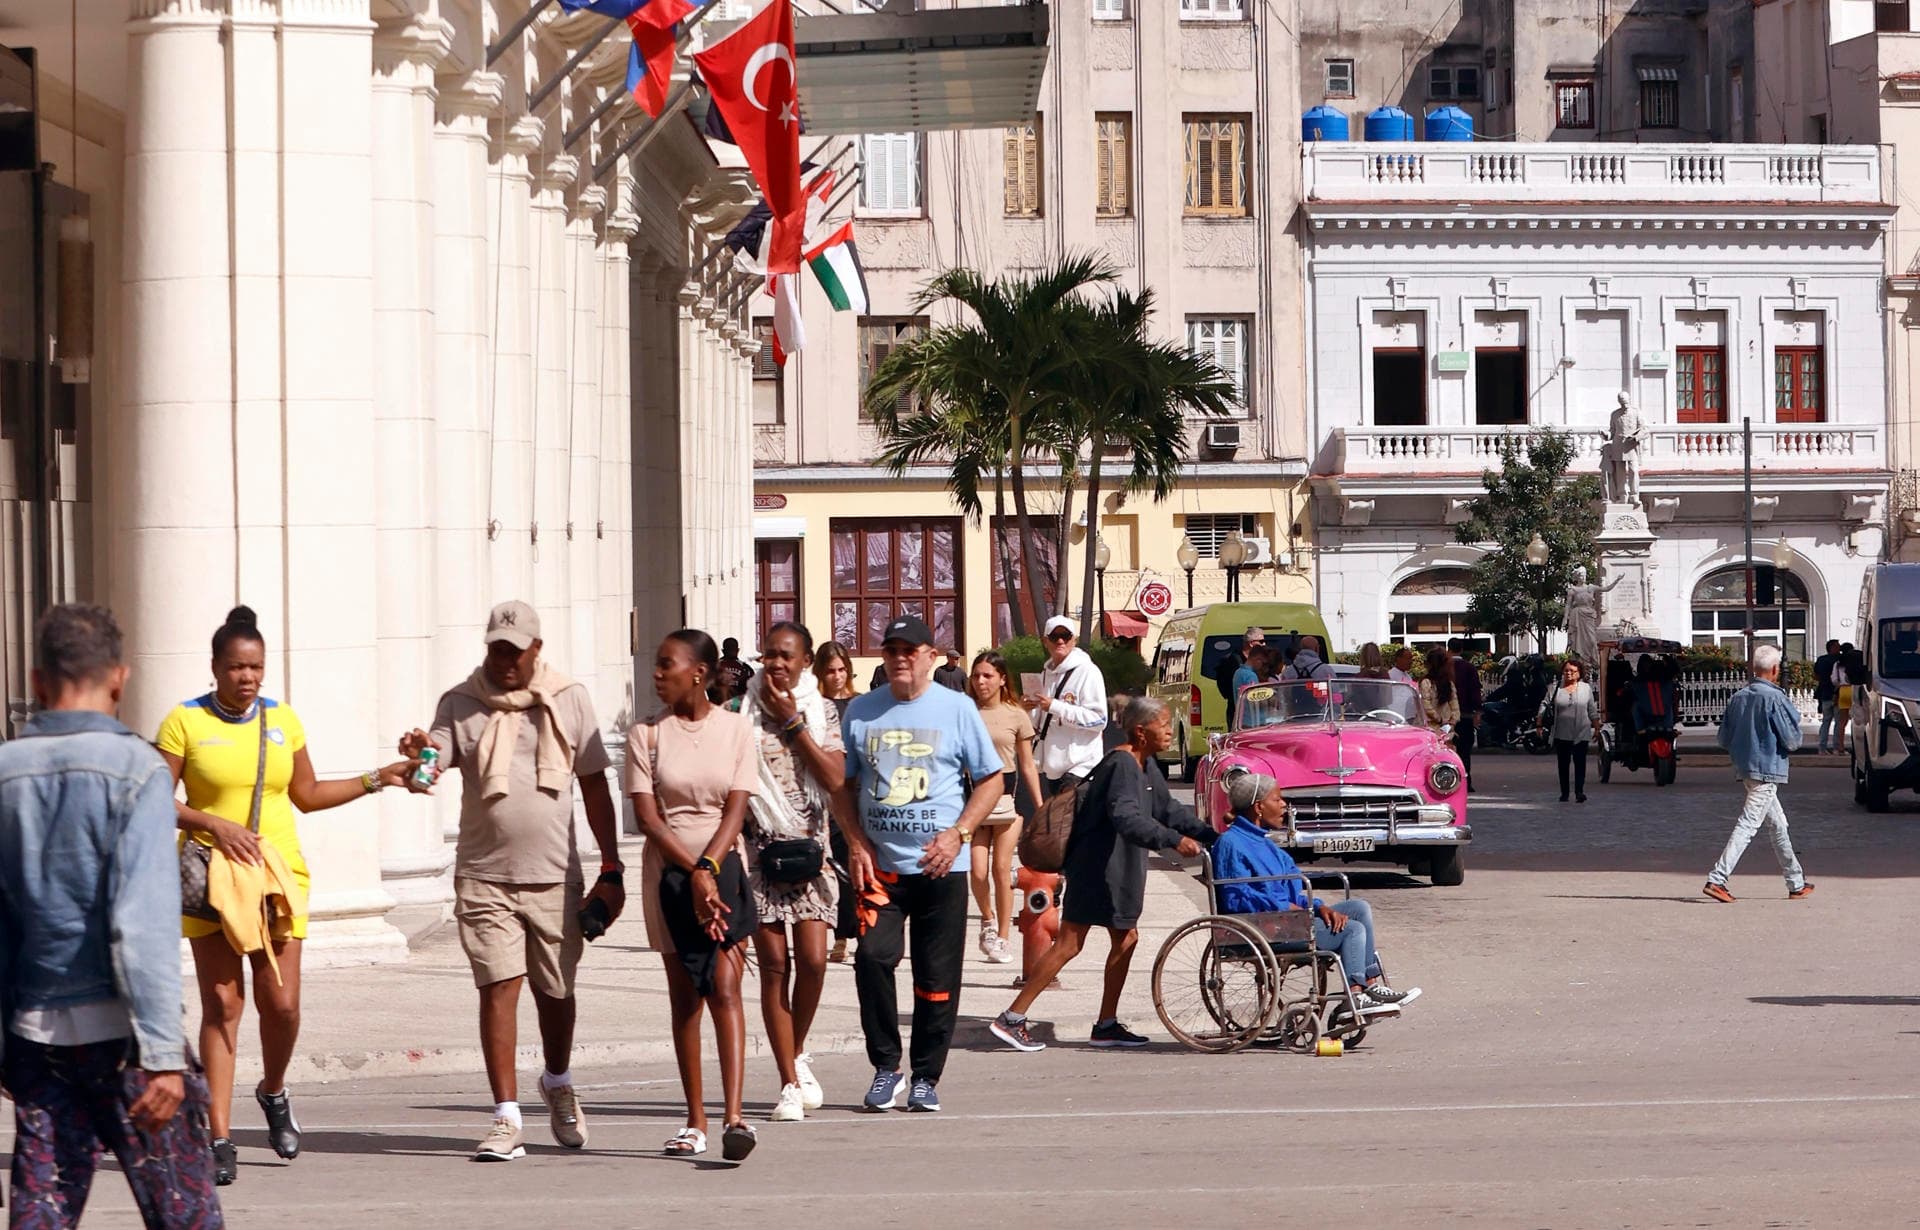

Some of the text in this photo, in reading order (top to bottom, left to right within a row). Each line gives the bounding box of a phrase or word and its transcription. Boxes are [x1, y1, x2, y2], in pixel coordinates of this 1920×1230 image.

[867, 808, 937, 820] ALWAYS BE
[868, 820, 939, 833] THANKFUL
[1321, 838, 1373, 852] P 109 317
